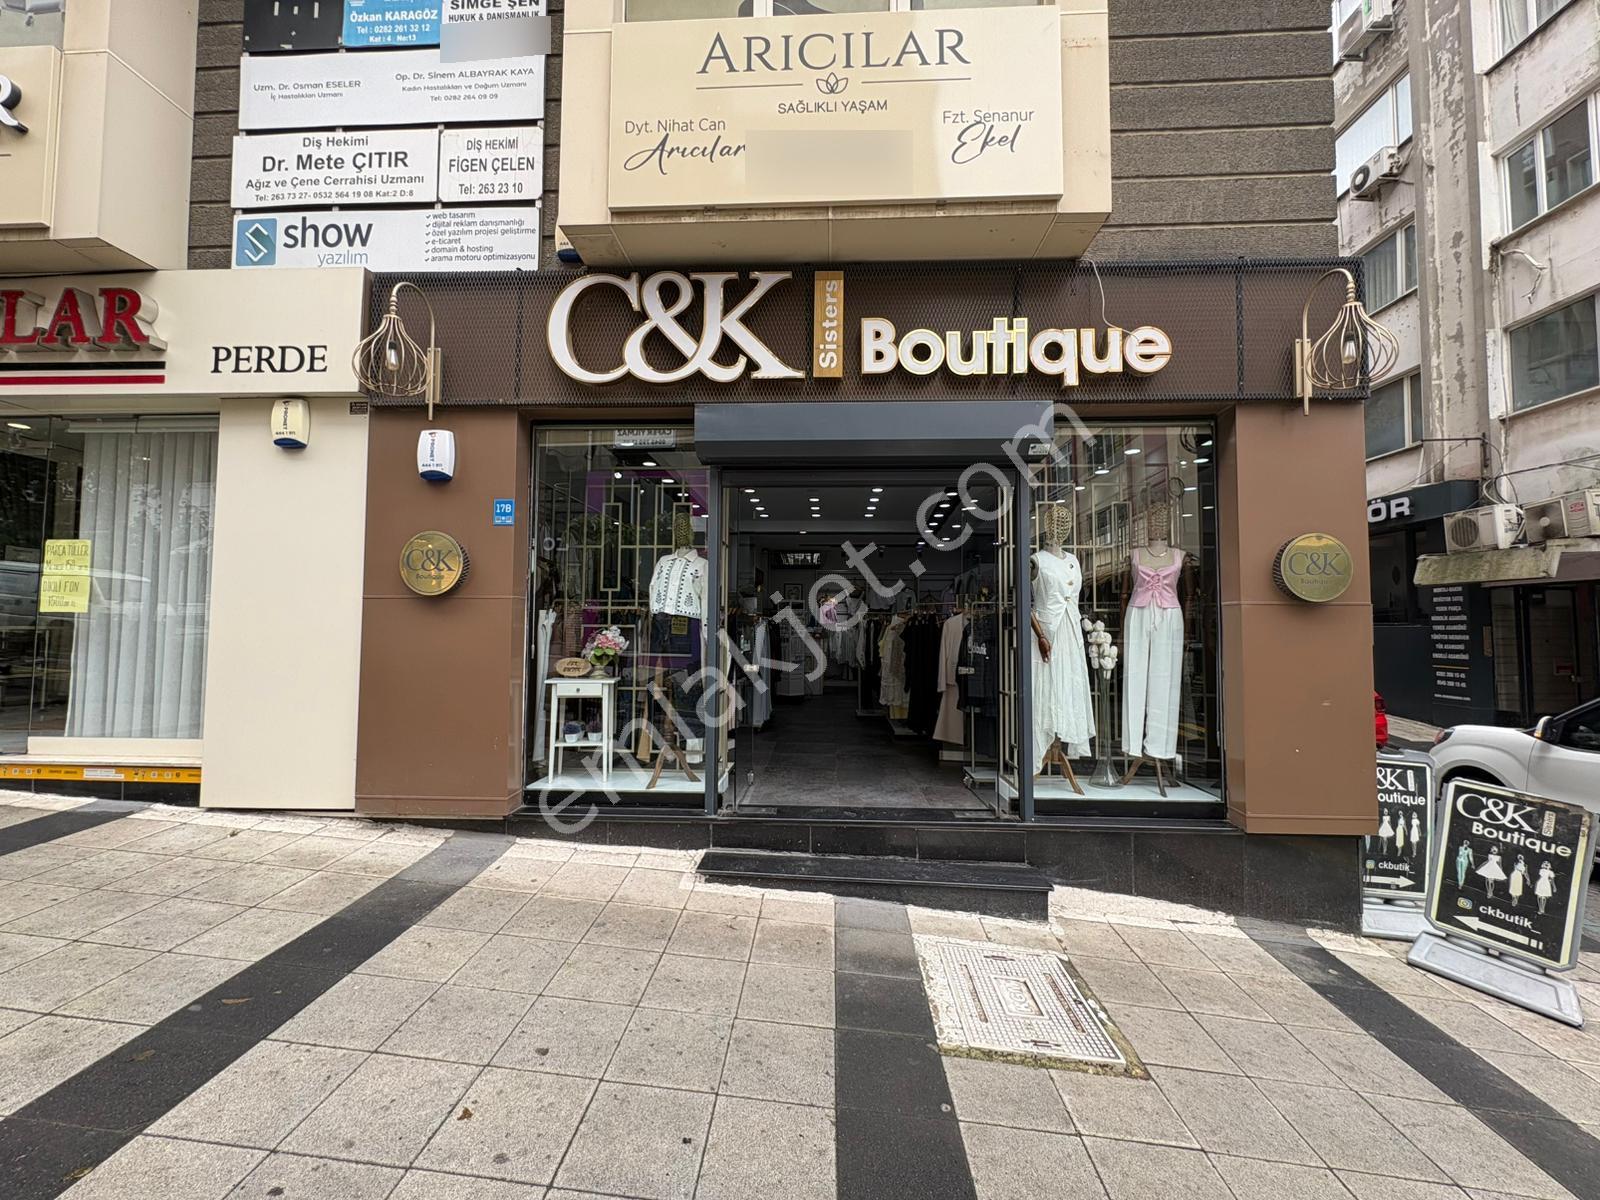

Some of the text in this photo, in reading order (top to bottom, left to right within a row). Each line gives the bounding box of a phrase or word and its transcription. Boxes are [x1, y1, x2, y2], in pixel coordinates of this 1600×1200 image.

[350, 8, 438, 22] Özkan KARAGÖZ
[449, 14, 476, 22] HUKUK
[357, 26, 368, 34] Tel
[374, 25, 392, 33] 0282
[410, 24, 419, 32] 32
[696, 28, 971, 74] ARICILAR
[395, 68, 535, 82] Op. Dr. Sinem ALBAYRAK KAYA
[253, 84, 276, 92] Uzm.
[292, 82, 323, 90] Osman
[326, 80, 361, 89] ESELER
[778, 99, 888, 114] SAĞLIKLI YAŞAM
[943, 110, 969, 124] Fzt.
[625, 118, 726, 136] Dyt. Nihat Can
[302, 136, 369, 150] Diş Hekimi
[466, 136, 519, 153] DİŞ HEKİMİ
[951, 121, 1021, 164] Ekel
[262, 151, 409, 173] Dr. Mete ÇITIR
[449, 156, 535, 175] FİGEN ÇELEN
[245, 174, 425, 191] Ağız ve Çene Cerrahisi Uzmanı
[459, 183, 523, 195] Tel: 263 23 10
[255, 194, 269, 202] Tel:
[271, 193, 285, 201] 263
[313, 191, 333, 199] 0532
[449, 211, 475, 219] tasarım
[283, 216, 373, 249] show
[432, 220, 451, 228] dijital
[432, 228, 446, 236] özel
[474, 228, 499, 236] projesi
[500, 227, 536, 236] geliştirme
[431, 237, 461, 245] e-ticaret
[466, 245, 494, 253] hosting
[317, 249, 368, 268] yazılım
[482, 253, 536, 262] optimizasyonu
[546, 269, 805, 384] C&K
[819, 280, 839, 368] Sisters
[211, 345, 328, 374] PERDE
[861, 316, 1173, 387] Boutique
[1367, 496, 1411, 523] ÖR
[406, 549, 456, 572] C&K
[1288, 552, 1345, 576] C&K
[1376, 767, 1407, 791] &K
[1377, 792, 1426, 806] outique
[1456, 793, 1538, 833] C&K
[1472, 822, 1572, 857] Boutique
